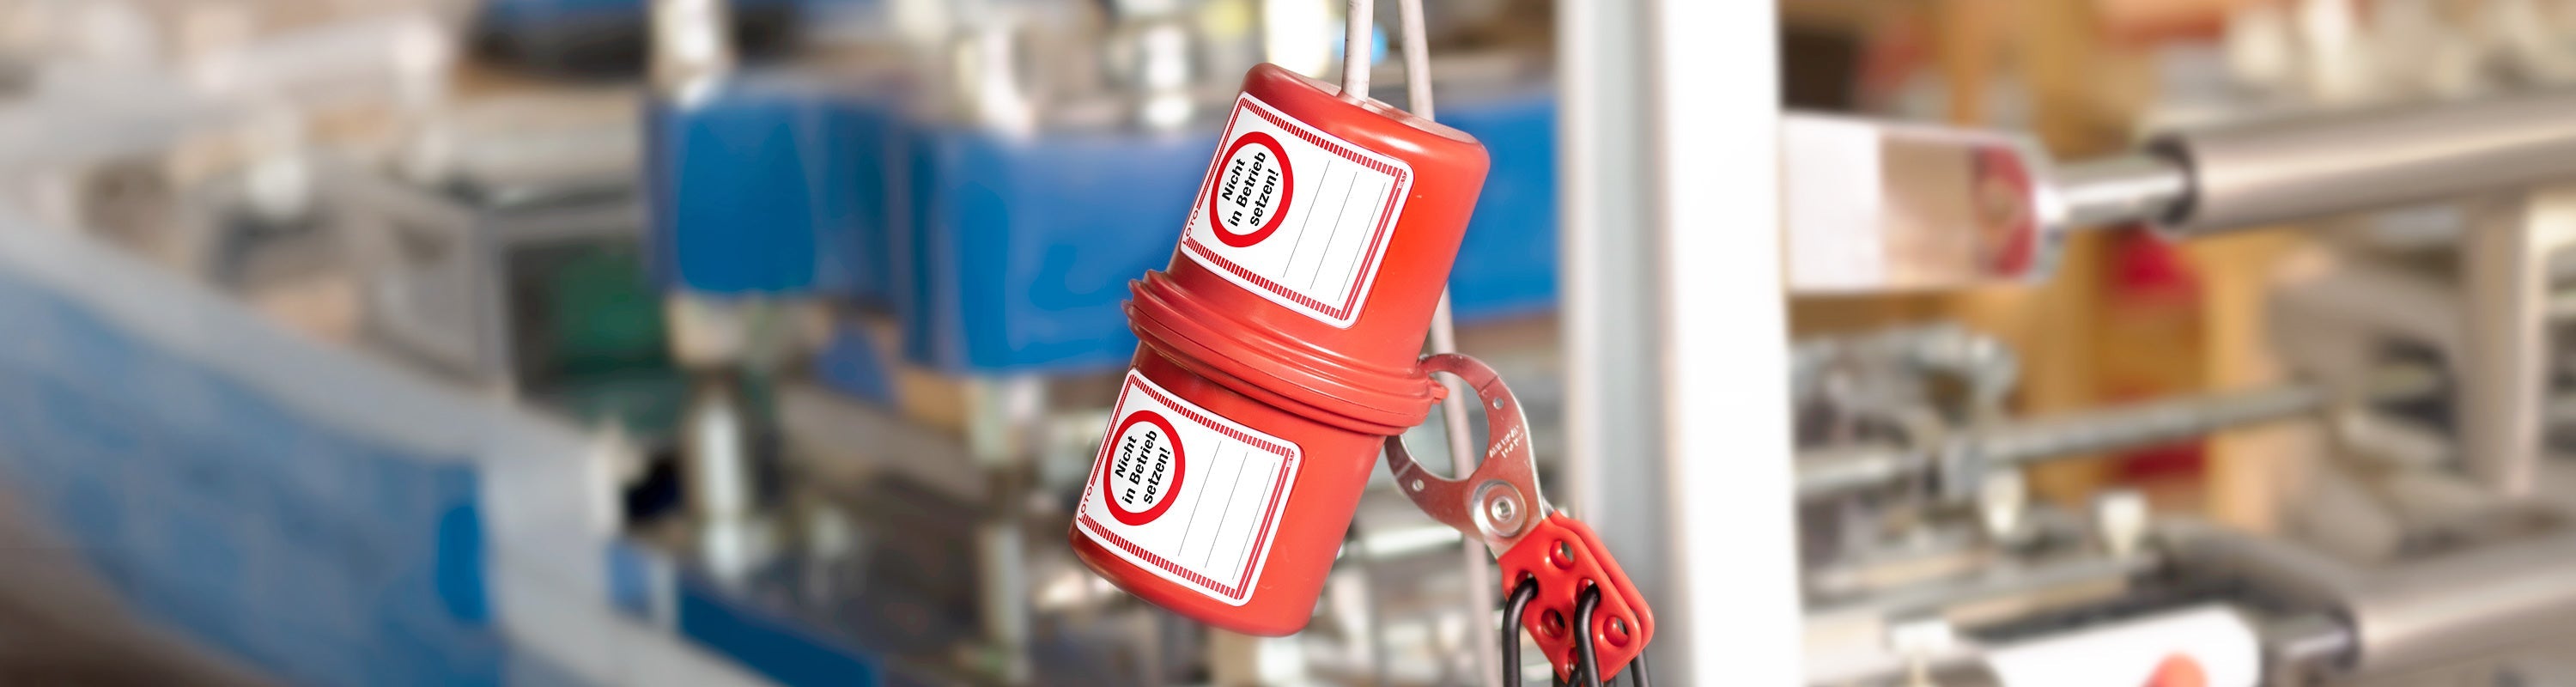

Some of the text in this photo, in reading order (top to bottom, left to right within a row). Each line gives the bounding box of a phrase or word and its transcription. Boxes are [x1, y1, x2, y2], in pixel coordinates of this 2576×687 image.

[1222, 158, 1245, 201] Nicht
[1228, 152, 1266, 227] in Betrieb
[1249, 168, 1279, 227] setzen!
[1115, 435, 1137, 478] Nicht
[1121, 430, 1157, 505] in Betrieb
[1144, 447, 1171, 505] setzen!
